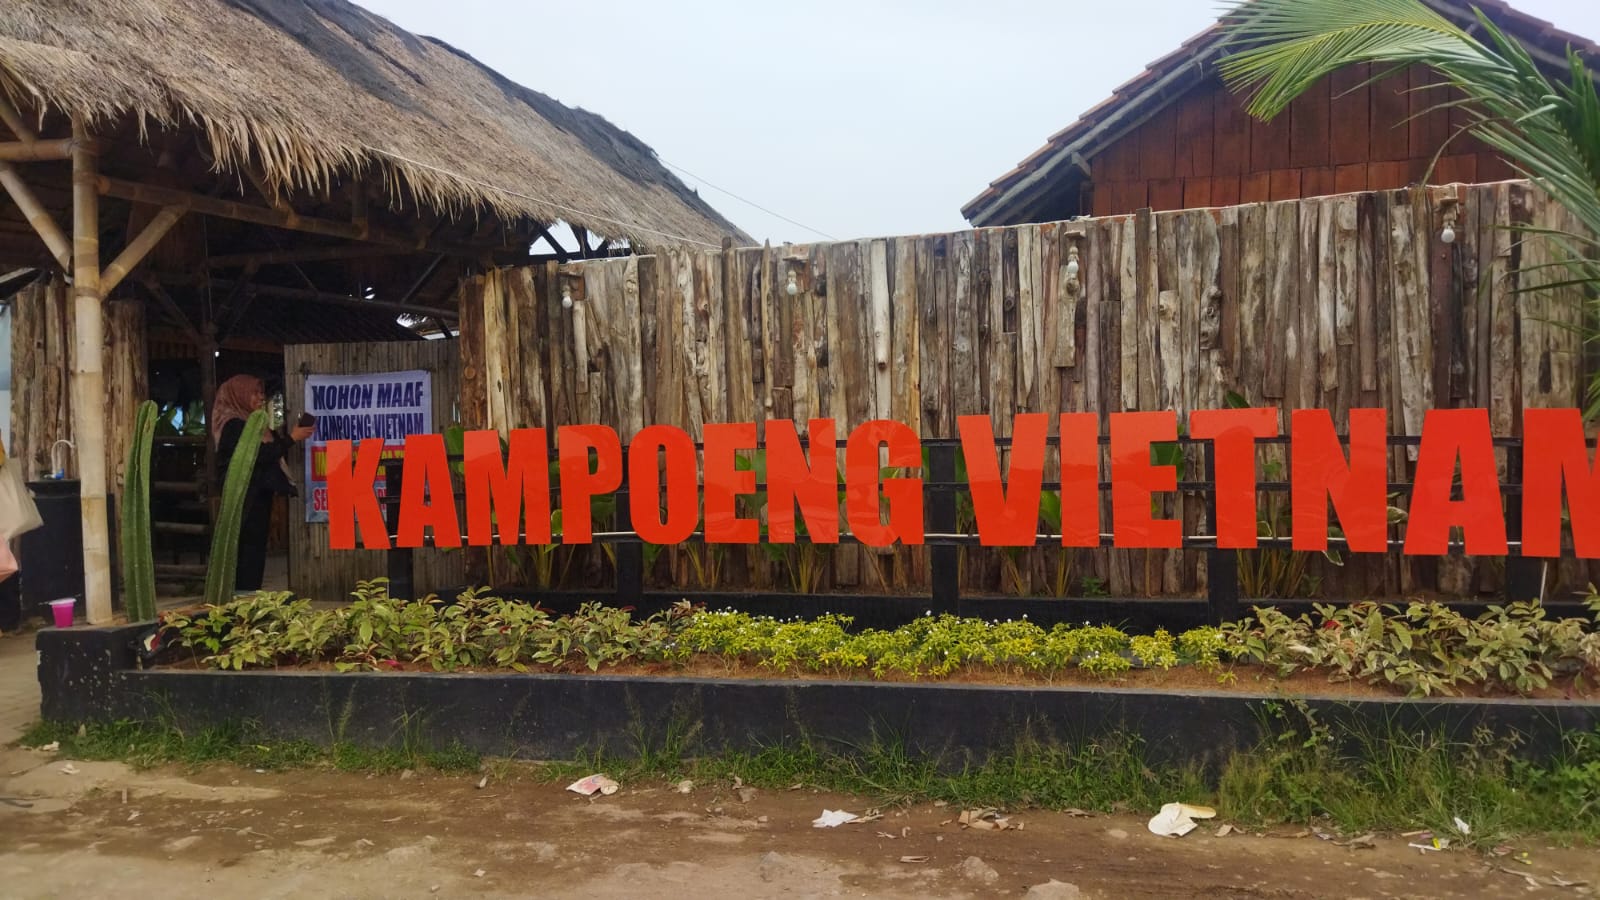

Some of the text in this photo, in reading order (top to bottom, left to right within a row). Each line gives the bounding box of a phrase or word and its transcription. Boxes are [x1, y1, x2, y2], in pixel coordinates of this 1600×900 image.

[312, 382, 423, 410] MOHON MAAF
[313, 413, 424, 441] KAMPOENG VIETNAM
[326, 407, 1600, 558] KAMPOENG VIETNAM
